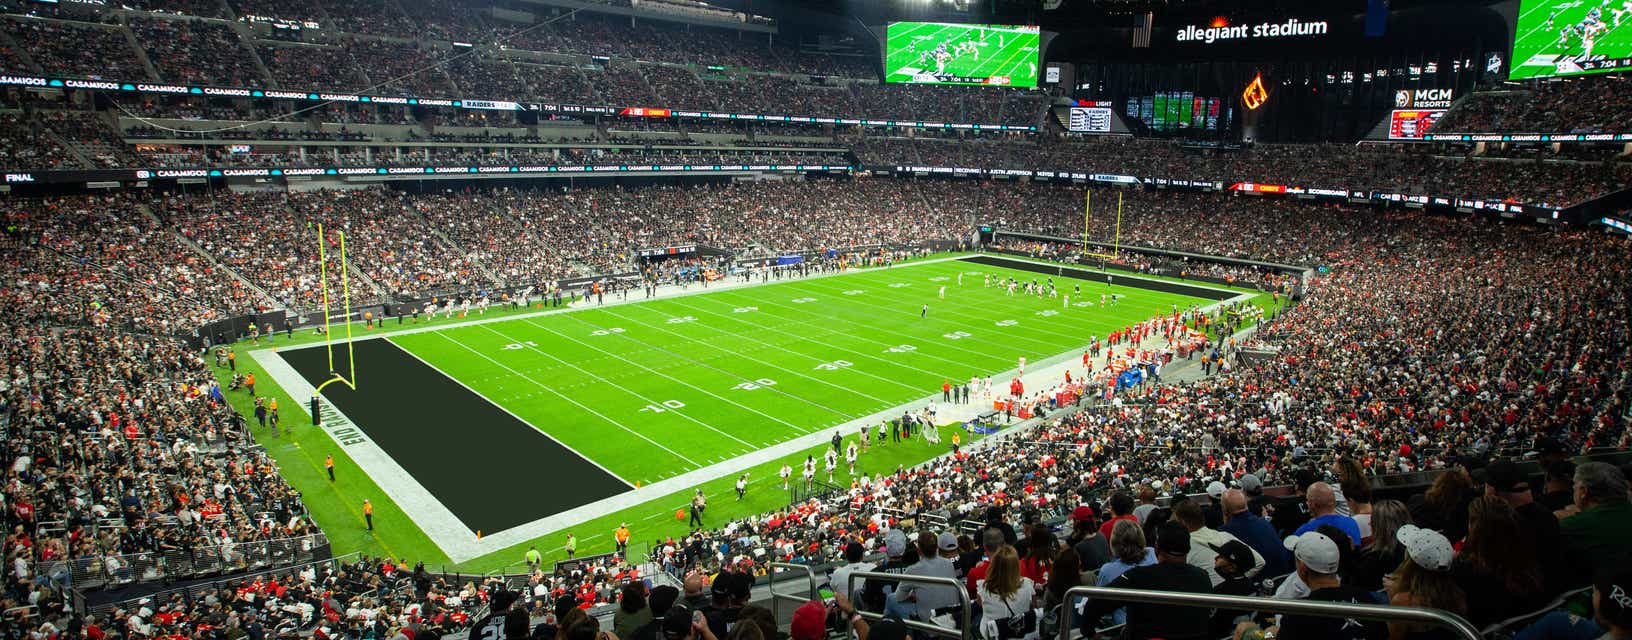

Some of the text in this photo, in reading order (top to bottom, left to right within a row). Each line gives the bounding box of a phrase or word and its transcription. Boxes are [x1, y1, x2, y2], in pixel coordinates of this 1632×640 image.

[1176, 18, 1328, 44] allegiant stadium
[66, 80, 119, 90] CASAMIGOS
[137, 83, 188, 93] CASAMIGOS
[204, 88, 250, 96] CASAMIGOS
[265, 91, 307, 100] CASAMIGOS
[320, 94, 359, 102] CASAMIGOS
[1414, 89, 1452, 100] MGM
[6, 174, 34, 182] FINAL
[819, 360, 853, 371] 30
[738, 378, 777, 390] 20
[644, 400, 686, 413] 10
[333, 428, 366, 446] END
